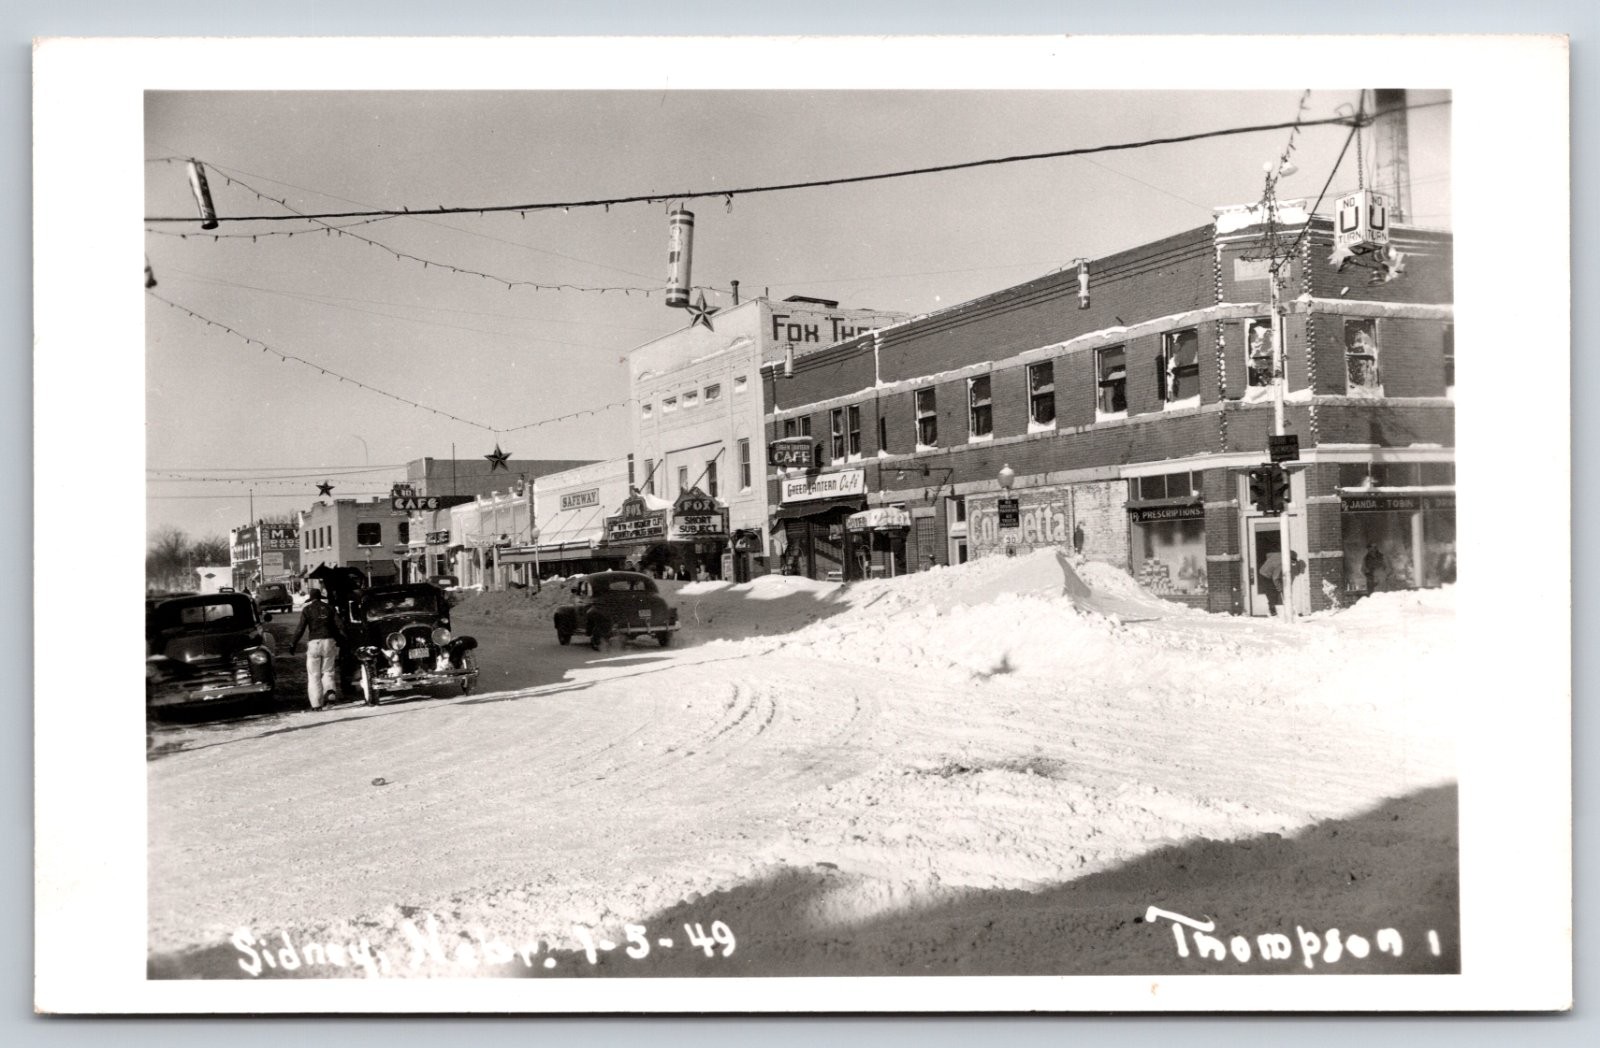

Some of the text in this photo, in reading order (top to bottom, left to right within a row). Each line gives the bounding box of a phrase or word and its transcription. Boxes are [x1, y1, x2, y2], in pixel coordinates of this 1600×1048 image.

[1343, 197, 1356, 208] NO
[1371, 196, 1383, 206] NO
[1340, 206, 1359, 233] U
[1369, 205, 1385, 231] U
[1339, 230, 1362, 243] TURN
[1368, 229, 1387, 241] TURN
[774, 450, 811, 464] CAFE
[787, 483, 807, 497] GREEN
[394, 498, 439, 510] CAFE
[562, 491, 597, 508] SAFEWAY
[683, 501, 711, 511] FOX
[1142, 508, 1201, 519] PRESCRIPTIONS
[684, 516, 712, 524] SHORT
[679, 524, 717, 533] SUBJECT
